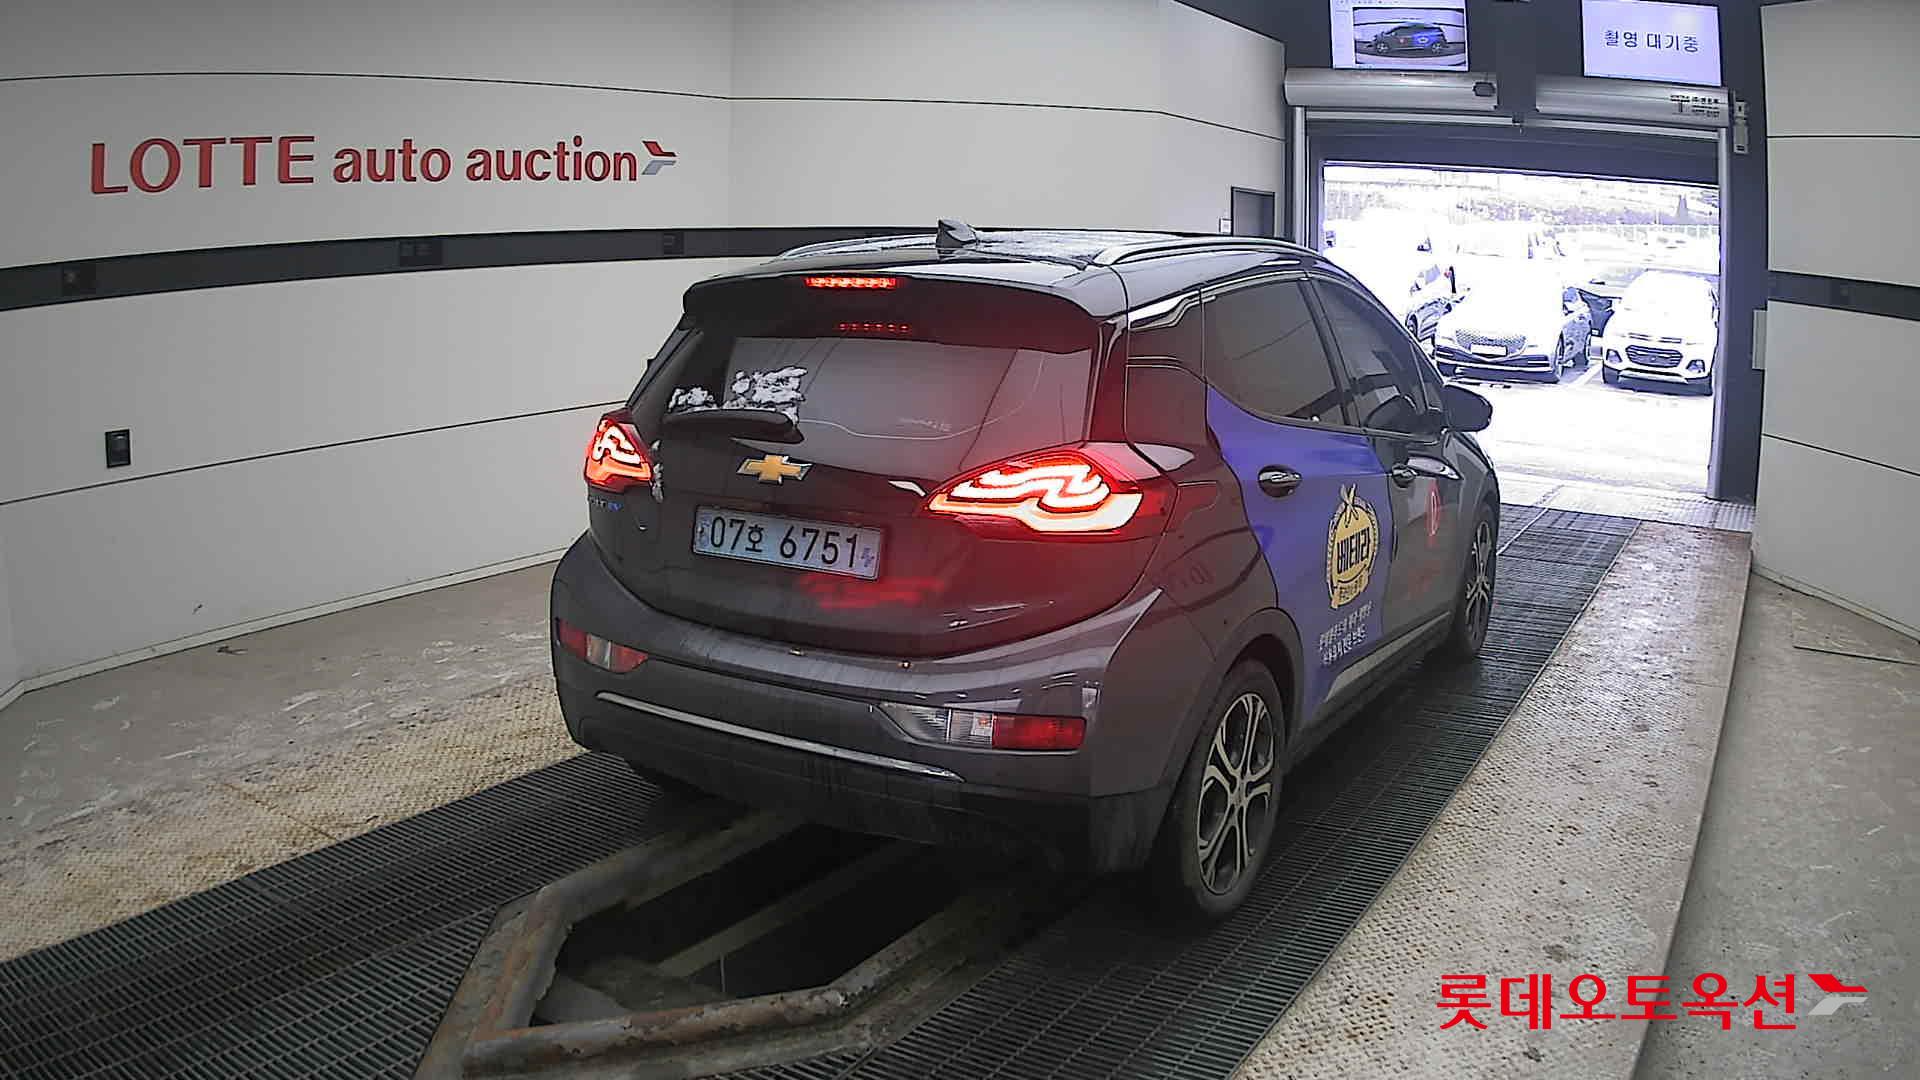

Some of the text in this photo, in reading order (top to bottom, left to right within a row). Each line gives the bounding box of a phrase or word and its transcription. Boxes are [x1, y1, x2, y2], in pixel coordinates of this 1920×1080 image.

[1646, 32, 1699, 53] 대기중
[90, 135, 639, 194] LOTTE auto auction
[710, 515, 766, 553] 07호
[779, 525, 859, 569] 6751
